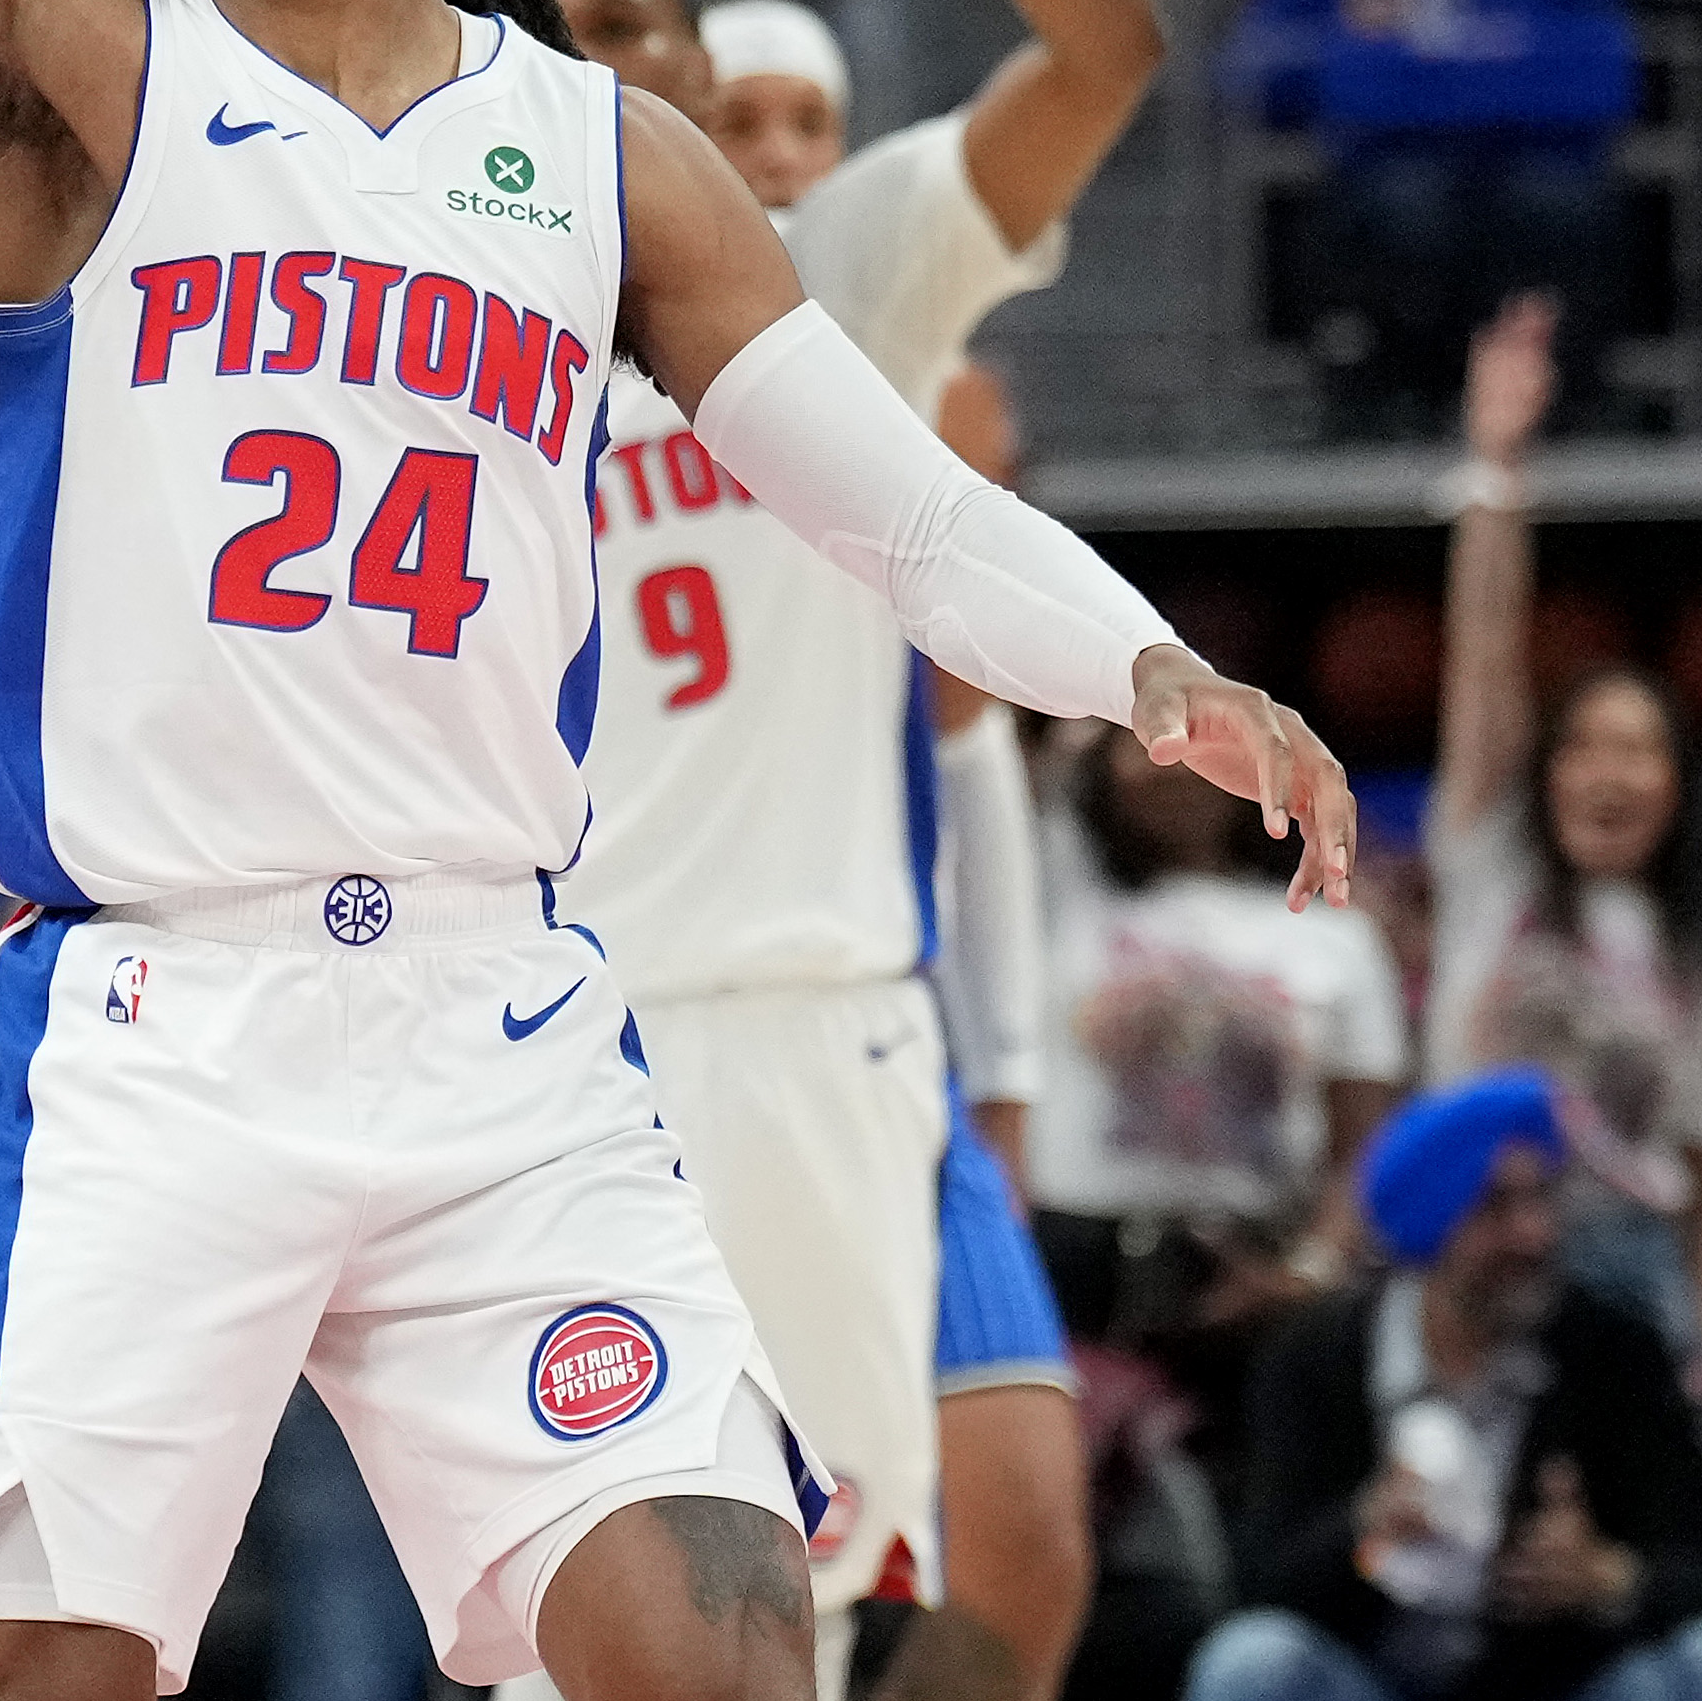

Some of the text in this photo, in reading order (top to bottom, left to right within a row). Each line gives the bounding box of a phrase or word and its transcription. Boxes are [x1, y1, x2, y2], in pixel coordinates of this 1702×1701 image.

[446, 189, 573, 235] StockX
[130, 250, 589, 466] PISTONS
[593, 429, 754, 541] TO
[207, 429, 490, 661] 24
[635, 563, 729, 714] 9
[548, 1340, 634, 1386] DETROIT
[552, 1361, 640, 1409] PISTONS
